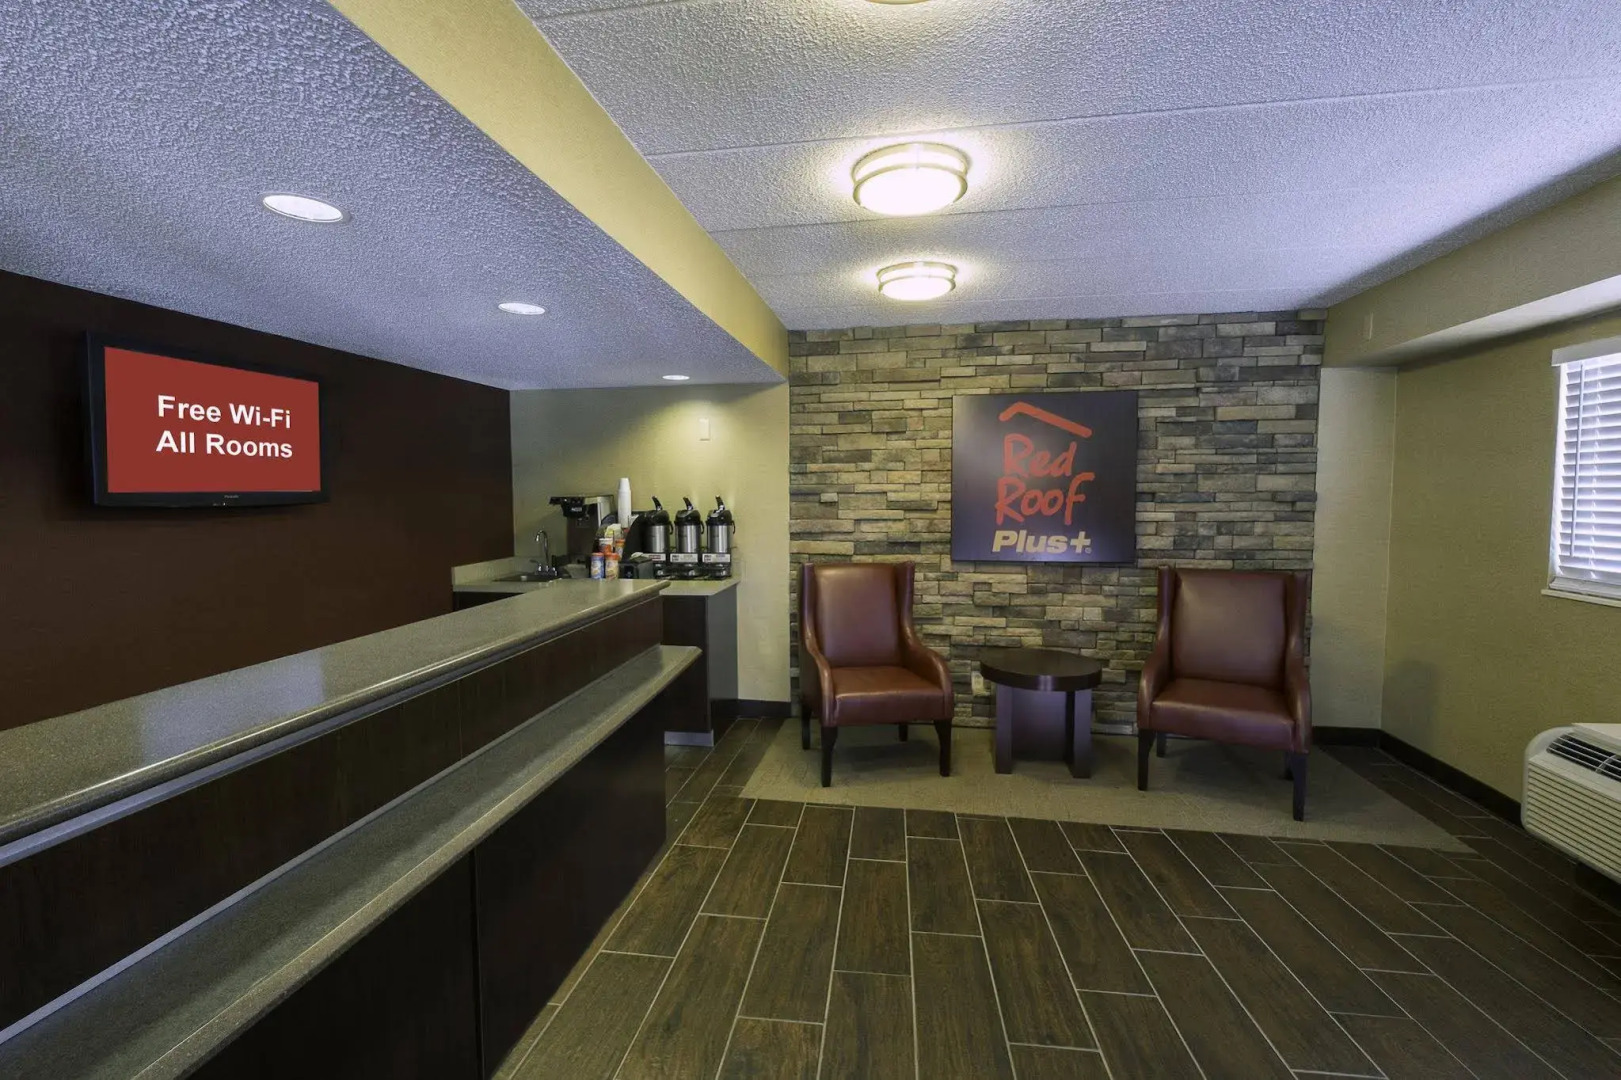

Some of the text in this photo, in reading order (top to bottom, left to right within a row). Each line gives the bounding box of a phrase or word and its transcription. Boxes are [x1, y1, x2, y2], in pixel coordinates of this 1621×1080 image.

[158, 394, 291, 428] Free Wi-Fi
[156, 431, 293, 458] All Rooms
[1003, 433, 1077, 478] Red
[995, 472, 1095, 526] Roof
